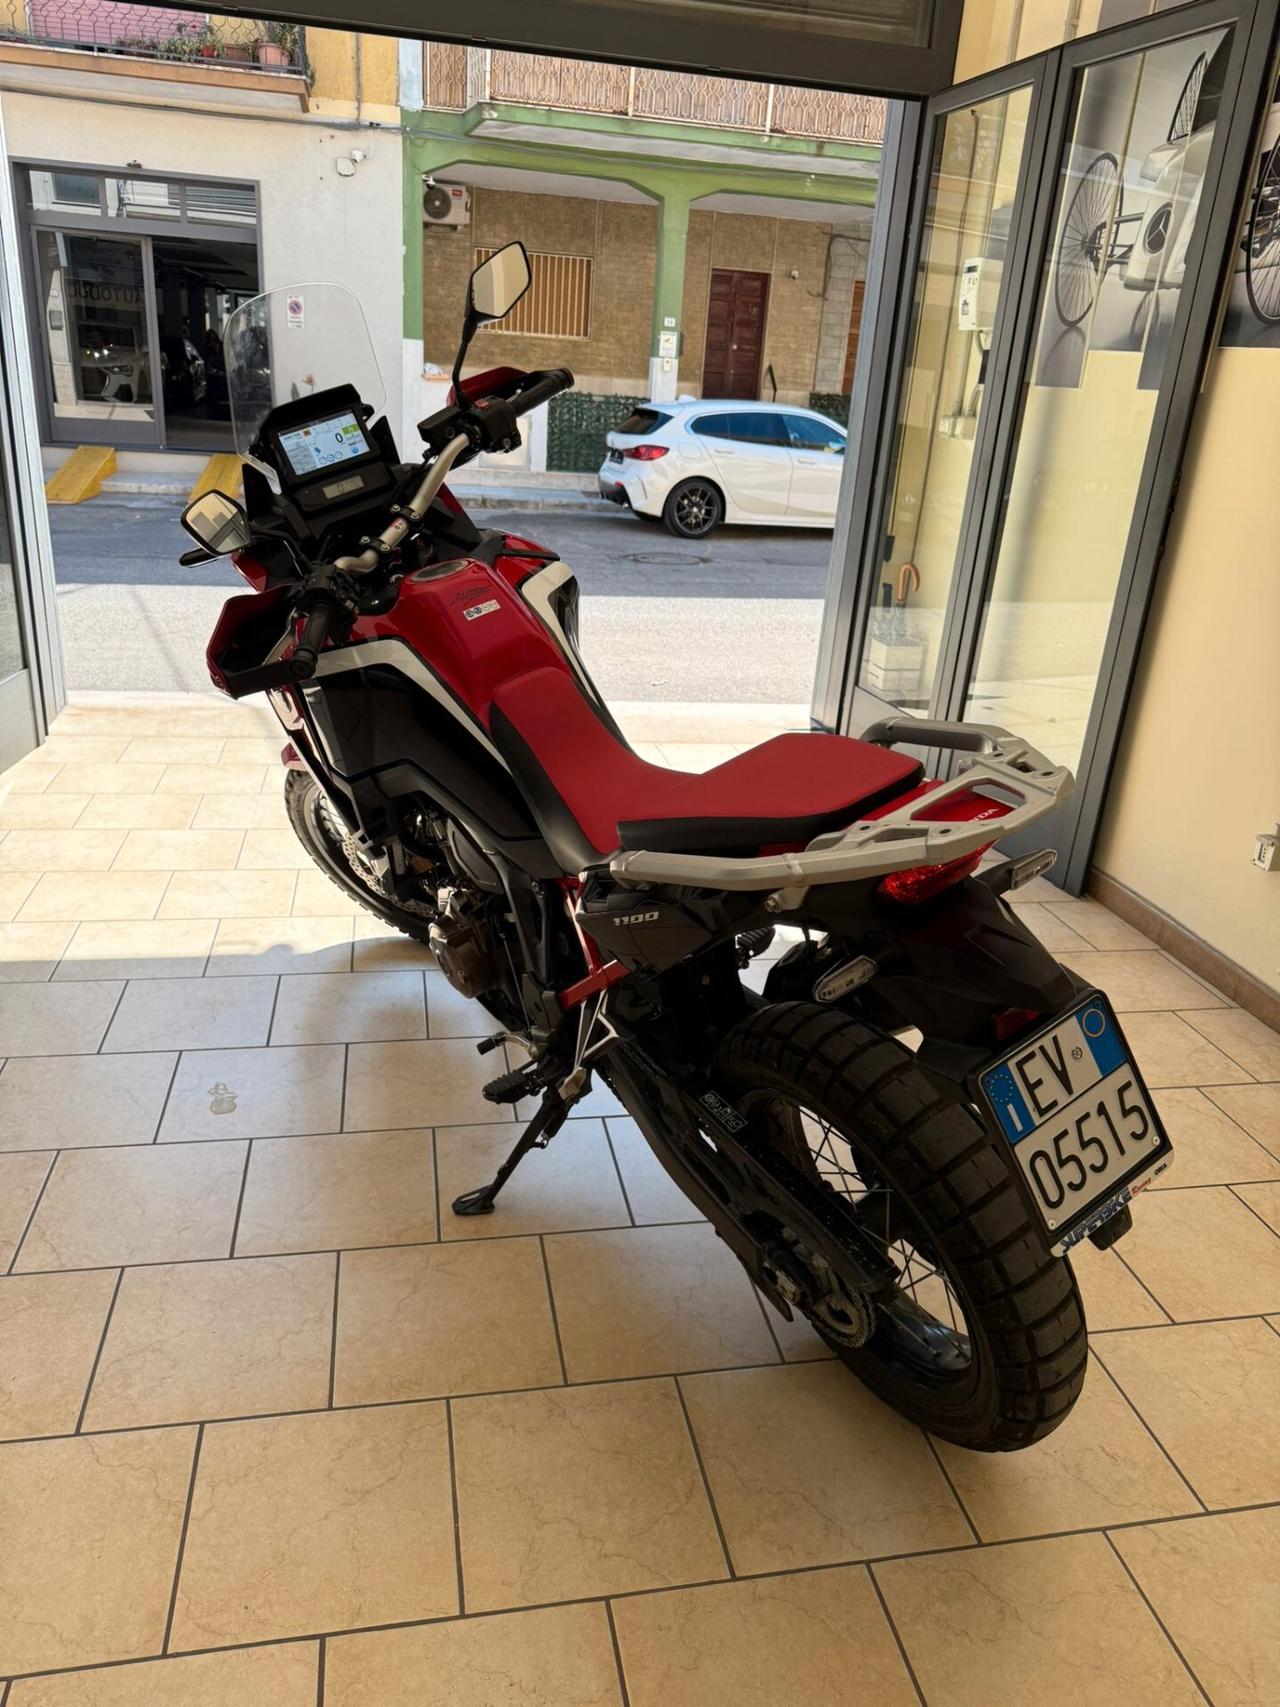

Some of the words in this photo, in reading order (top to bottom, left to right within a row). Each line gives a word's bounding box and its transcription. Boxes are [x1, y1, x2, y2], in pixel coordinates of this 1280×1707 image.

[335, 432, 344, 443] 0
[613, 911, 659, 926] 1100
[1015, 1034, 1074, 1118] EV
[1029, 1079, 1149, 1209] 05515
